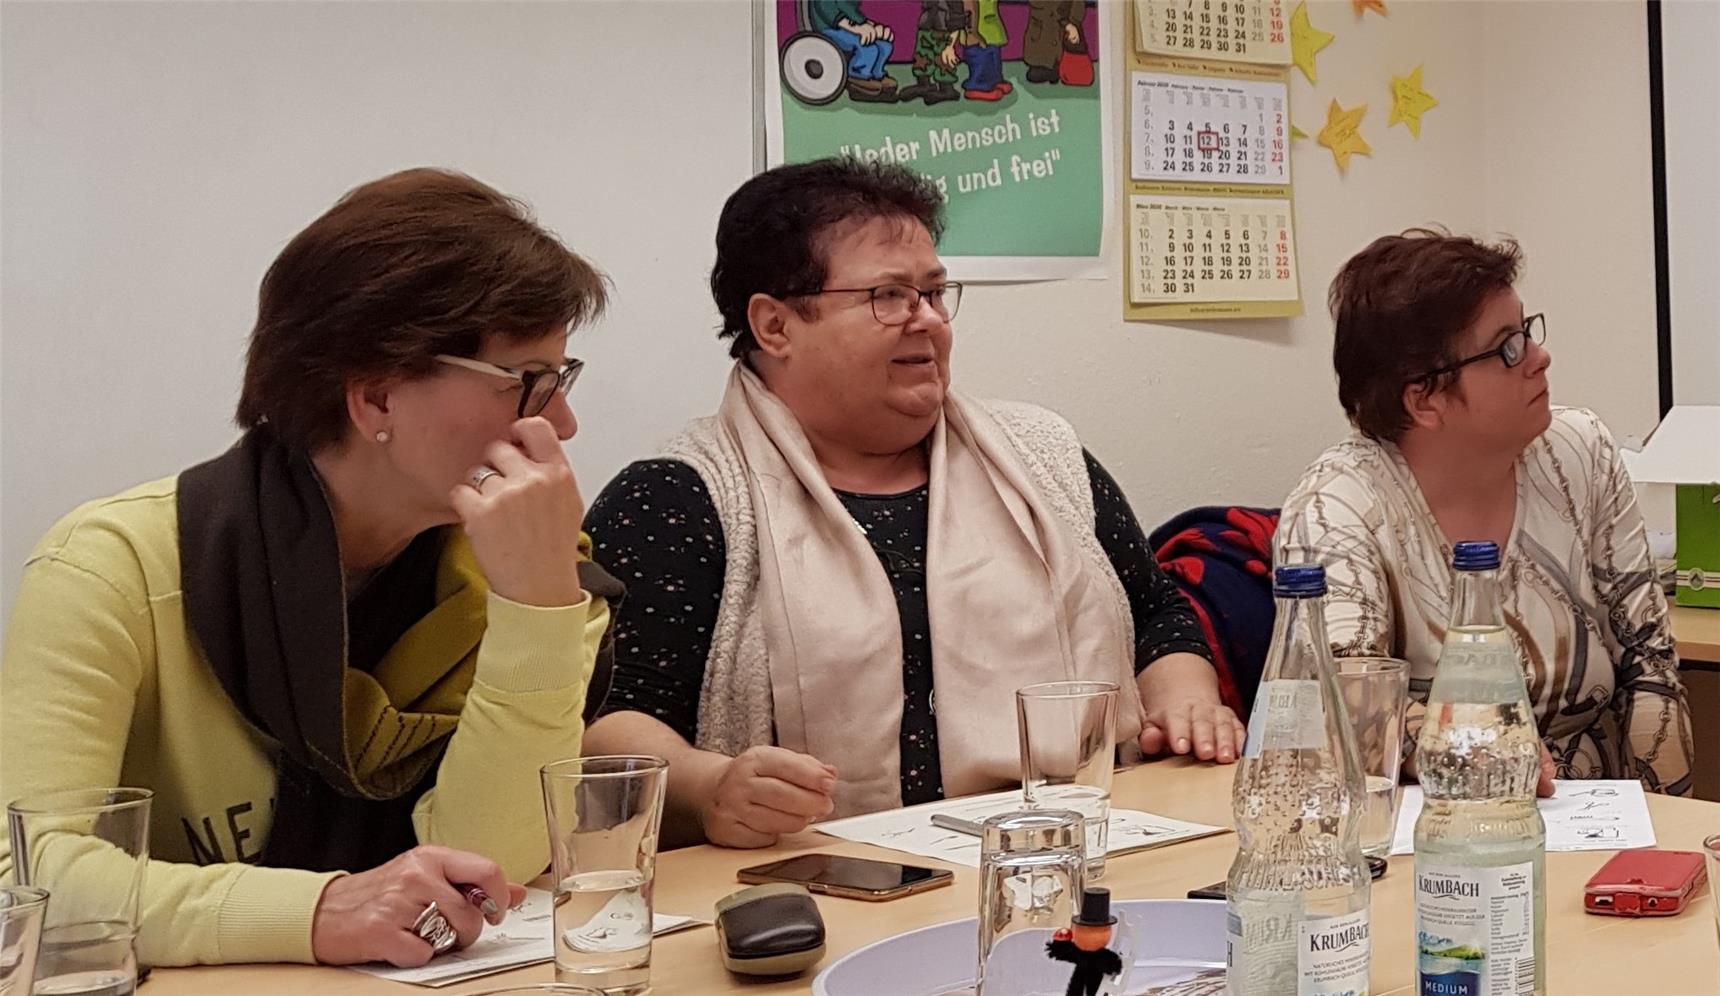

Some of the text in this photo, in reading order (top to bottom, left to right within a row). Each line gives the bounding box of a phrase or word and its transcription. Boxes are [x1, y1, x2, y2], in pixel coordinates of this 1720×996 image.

[1234, 4, 1245, 15] 10
[1270, 8, 1281, 17] 12
[1166, 9, 1176, 19] 13
[1183, 11, 1193, 21] 14
[1200, 13, 1210, 23] 15
[1216, 15, 1228, 25] 16
[1235, 17, 1245, 27] 17
[1165, 22, 1177, 33] 20
[1183, 24, 1193, 34] 21
[1200, 26, 1211, 37] 22
[1216, 28, 1228, 38] 23
[1234, 30, 1246, 40] 24
[1270, 33, 1284, 43] 26
[1166, 35, 1177, 46] 27
[1183, 38, 1195, 48] 28
[1200, 40, 1212, 50] 29
[1216, 41, 1229, 51] 30
[1235, 43, 1246, 54] 31
[1276, 114, 1282, 124] 2
[928, 114, 1022, 157] Mensch
[1029, 109, 1061, 137] ist
[1168, 120, 1174, 131] 3
[1187, 122, 1193, 132] 4
[1223, 123, 1229, 134] 6
[1241, 124, 1247, 135] 7
[1164, 134, 1175, 144] 10
[1184, 135, 1192, 145] 11
[1201, 136, 1211, 146] 12
[1219, 137, 1230, 147] 13
[1238, 138, 1247, 148] 14
[1165, 147, 1175, 157] 17
[1184, 148, 1194, 158] 18
[1202, 149, 1212, 159] 19
[1218, 150, 1230, 160] 20
[1237, 151, 1247, 161] 21
[1254, 152, 1265, 161] 22
[1272, 152, 1283, 162] 23
[957, 159, 1002, 192] und
[1010, 149, 1061, 183] frei"
[1163, 161, 1175, 171] 24
[1182, 162, 1194, 172] 25
[1200, 163, 1213, 173] 26
[1218, 164, 1230, 174] 27
[1236, 164, 1249, 174] 28
[1278, 165, 1283, 175] 1
[1168, 229, 1174, 239] 2
[1187, 229, 1193, 239] 3
[1206, 230, 1212, 239] 4
[1224, 230, 1230, 240] 5
[1243, 230, 1249, 240] 6
[1262, 231, 1267, 240] 7
[1169, 242, 1175, 253] 9
[1183, 243, 1194, 253] 10
[1202, 243, 1212, 253] 11
[1220, 243, 1231, 253] 12
[1239, 243, 1250, 253] 13
[1258, 243, 1268, 253] 14
[1276, 243, 1288, 253] 15
[1165, 256, 1175, 266] 16
[1184, 256, 1194, 266] 17
[1202, 256, 1213, 266] 18
[1221, 256, 1232, 266] 19
[1238, 256, 1251, 266] 20
[1258, 256, 1269, 266] 21
[1276, 256, 1288, 266] 22
[1163, 269, 1176, 280] 23
[1182, 269, 1194, 280] 24
[1201, 269, 1214, 280] 25
[1220, 269, 1233, 280] 26
[1239, 269, 1251, 280] 27
[1258, 269, 1271, 280] 28
[1277, 269, 1289, 279] 29
[1163, 283, 1176, 293] 30
[1183, 283, 1195, 293] 31
[181, 798, 275, 866] NE
[1418, 874, 1480, 898] KRUMBACH
[1425, 981, 1468, 995] MEDIUM
